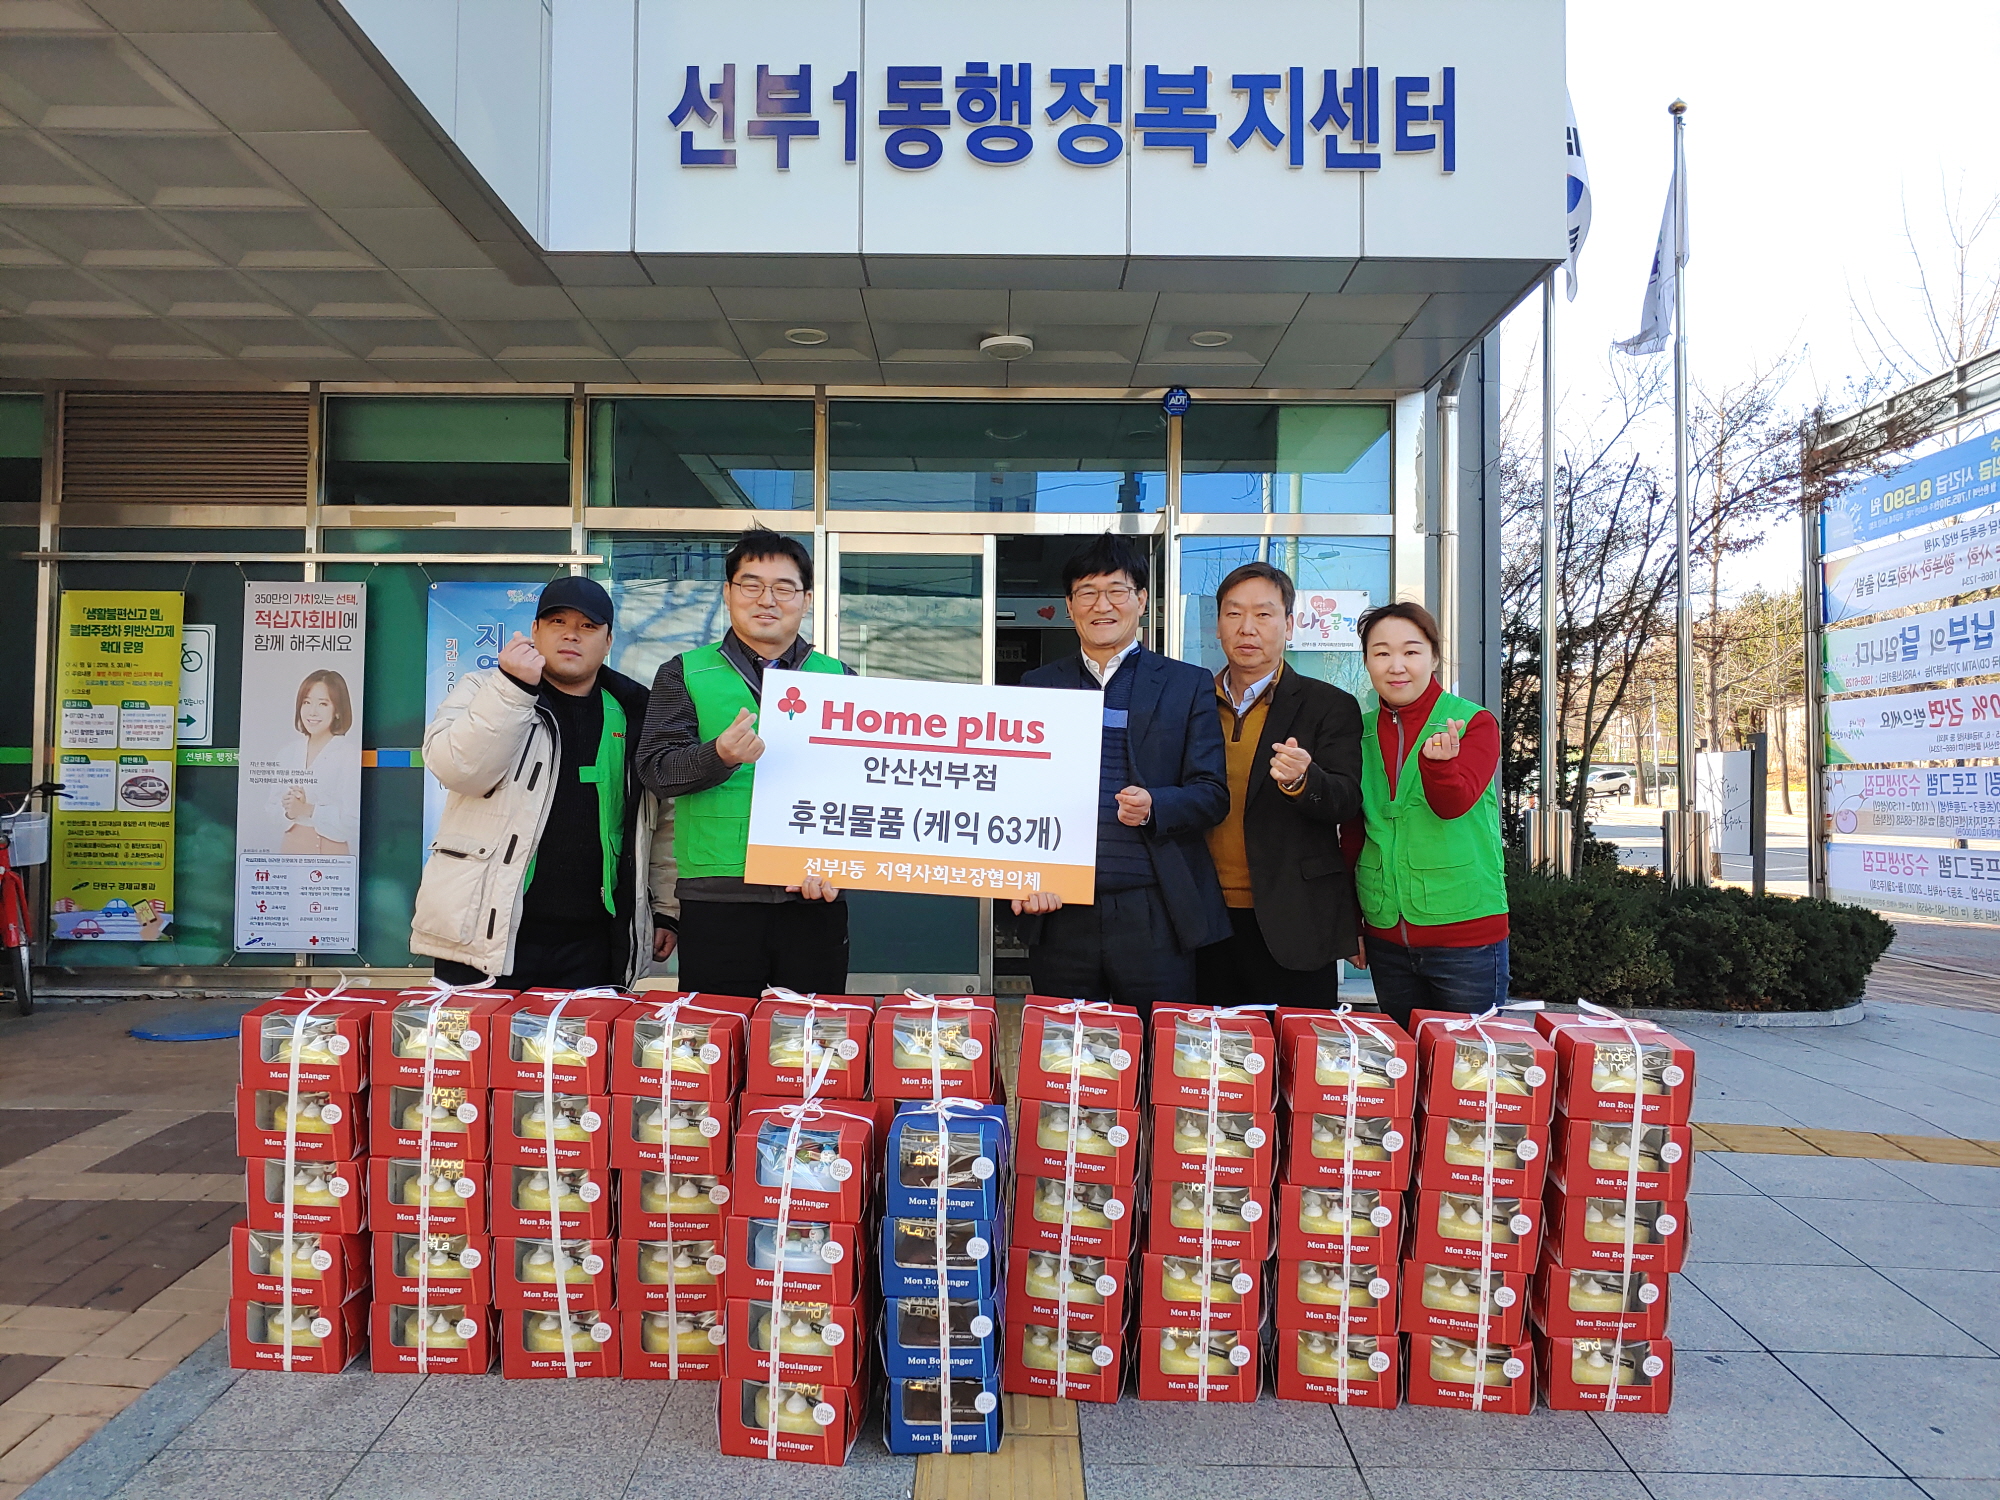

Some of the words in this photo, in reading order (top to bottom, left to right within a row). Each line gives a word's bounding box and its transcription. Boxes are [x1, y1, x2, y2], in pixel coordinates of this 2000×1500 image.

[668, 61, 1456, 175] 선부1동행정복지센터
[1169, 396, 1187, 405] ADT
[254, 593, 292, 605] 350만의
[294, 593, 335, 605] 가치있는
[336, 593, 358, 606] 선택,
[254, 610, 358, 630] 적십자회비에
[70, 624, 121, 637] 불법주정차
[123, 625, 175, 637] 위반신고제
[100, 641, 120, 653] 확대
[123, 641, 144, 653] 운영
[254, 634, 285, 652] 함께
[290, 634, 352, 652] 해주세요
[821, 700, 947, 739] Home
[958, 712, 1045, 749] plus
[185, 752, 213, 762] 선부1동
[863, 756, 998, 792] 안산선부점
[788, 799, 905, 841] 후원물품
[913, 807, 980, 846] (케익
[987, 815, 1062, 851] 63개)
[803, 858, 867, 881] 선부1동
[875, 860, 1042, 892] 지역사회보장협의체
[269, 1071, 288, 1079] Mon
[901, 1077, 919, 1085] Mon
[1598, 1100, 1616, 1108] Mon
[669, 1221, 710, 1231] Boulanger
[1445, 1246, 1463, 1255] Mon
[755, 1278, 773, 1287] Mon
[783, 1280, 822, 1293] oulanger
[1429, 1316, 1447, 1325] Mon
[1575, 1318, 1593, 1327] Mon
[531, 1360, 548, 1368] Mon
[907, 1356, 926, 1365] Mon
[757, 1360, 769, 1369] Mo
[779, 1361, 823, 1374] Boulanger
